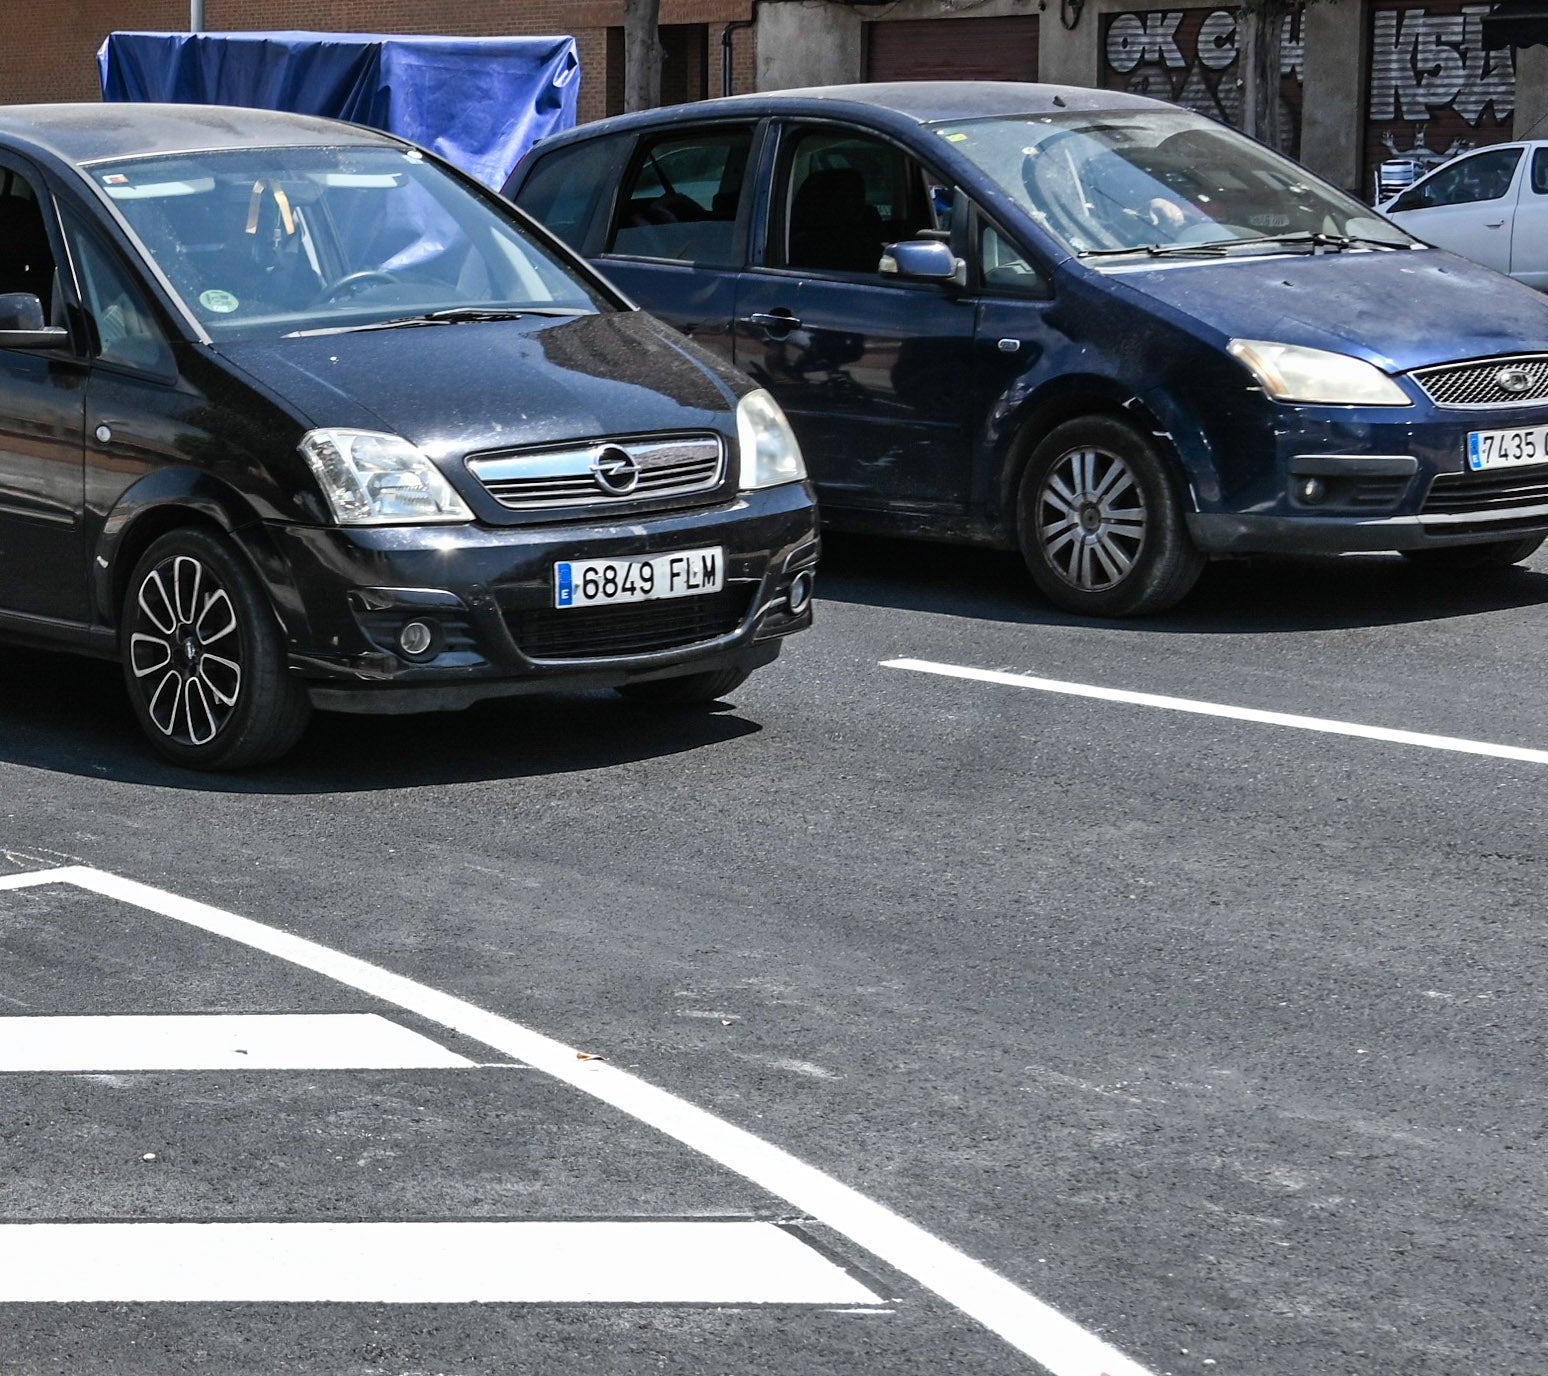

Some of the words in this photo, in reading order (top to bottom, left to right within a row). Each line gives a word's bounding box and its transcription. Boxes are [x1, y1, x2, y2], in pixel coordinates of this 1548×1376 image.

[1106, 12, 1188, 73] OK
[1482, 431, 1536, 463] 7435
[561, 589, 569, 599] E
[582, 561, 654, 600] 6849
[669, 553, 716, 592] FLM
